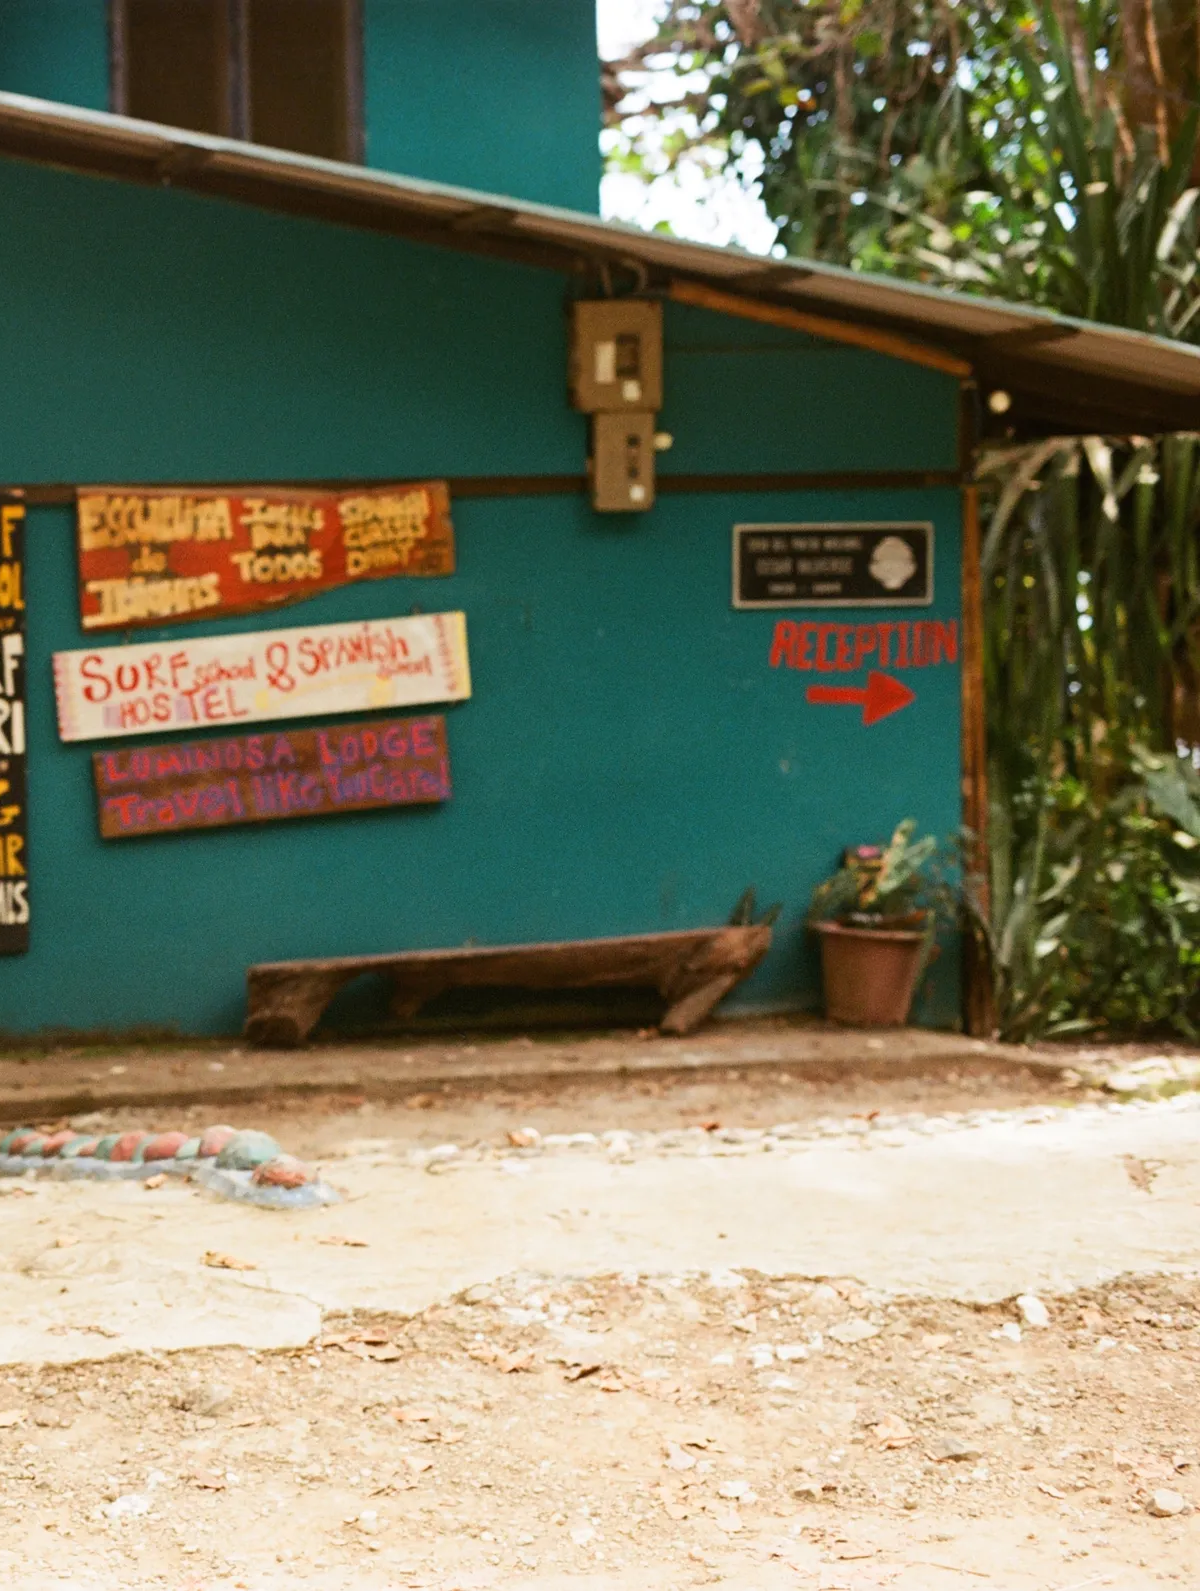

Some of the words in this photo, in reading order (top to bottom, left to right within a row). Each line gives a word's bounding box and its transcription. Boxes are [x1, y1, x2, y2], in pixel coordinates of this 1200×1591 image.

[230, 549, 325, 584] TODOS
[768, 618, 959, 673] RECEPTION
[79, 650, 189, 704] SURF
[119, 685, 250, 729] HOSTEL
[317, 721, 438, 766] LODGE
[104, 776, 247, 831] Travel
